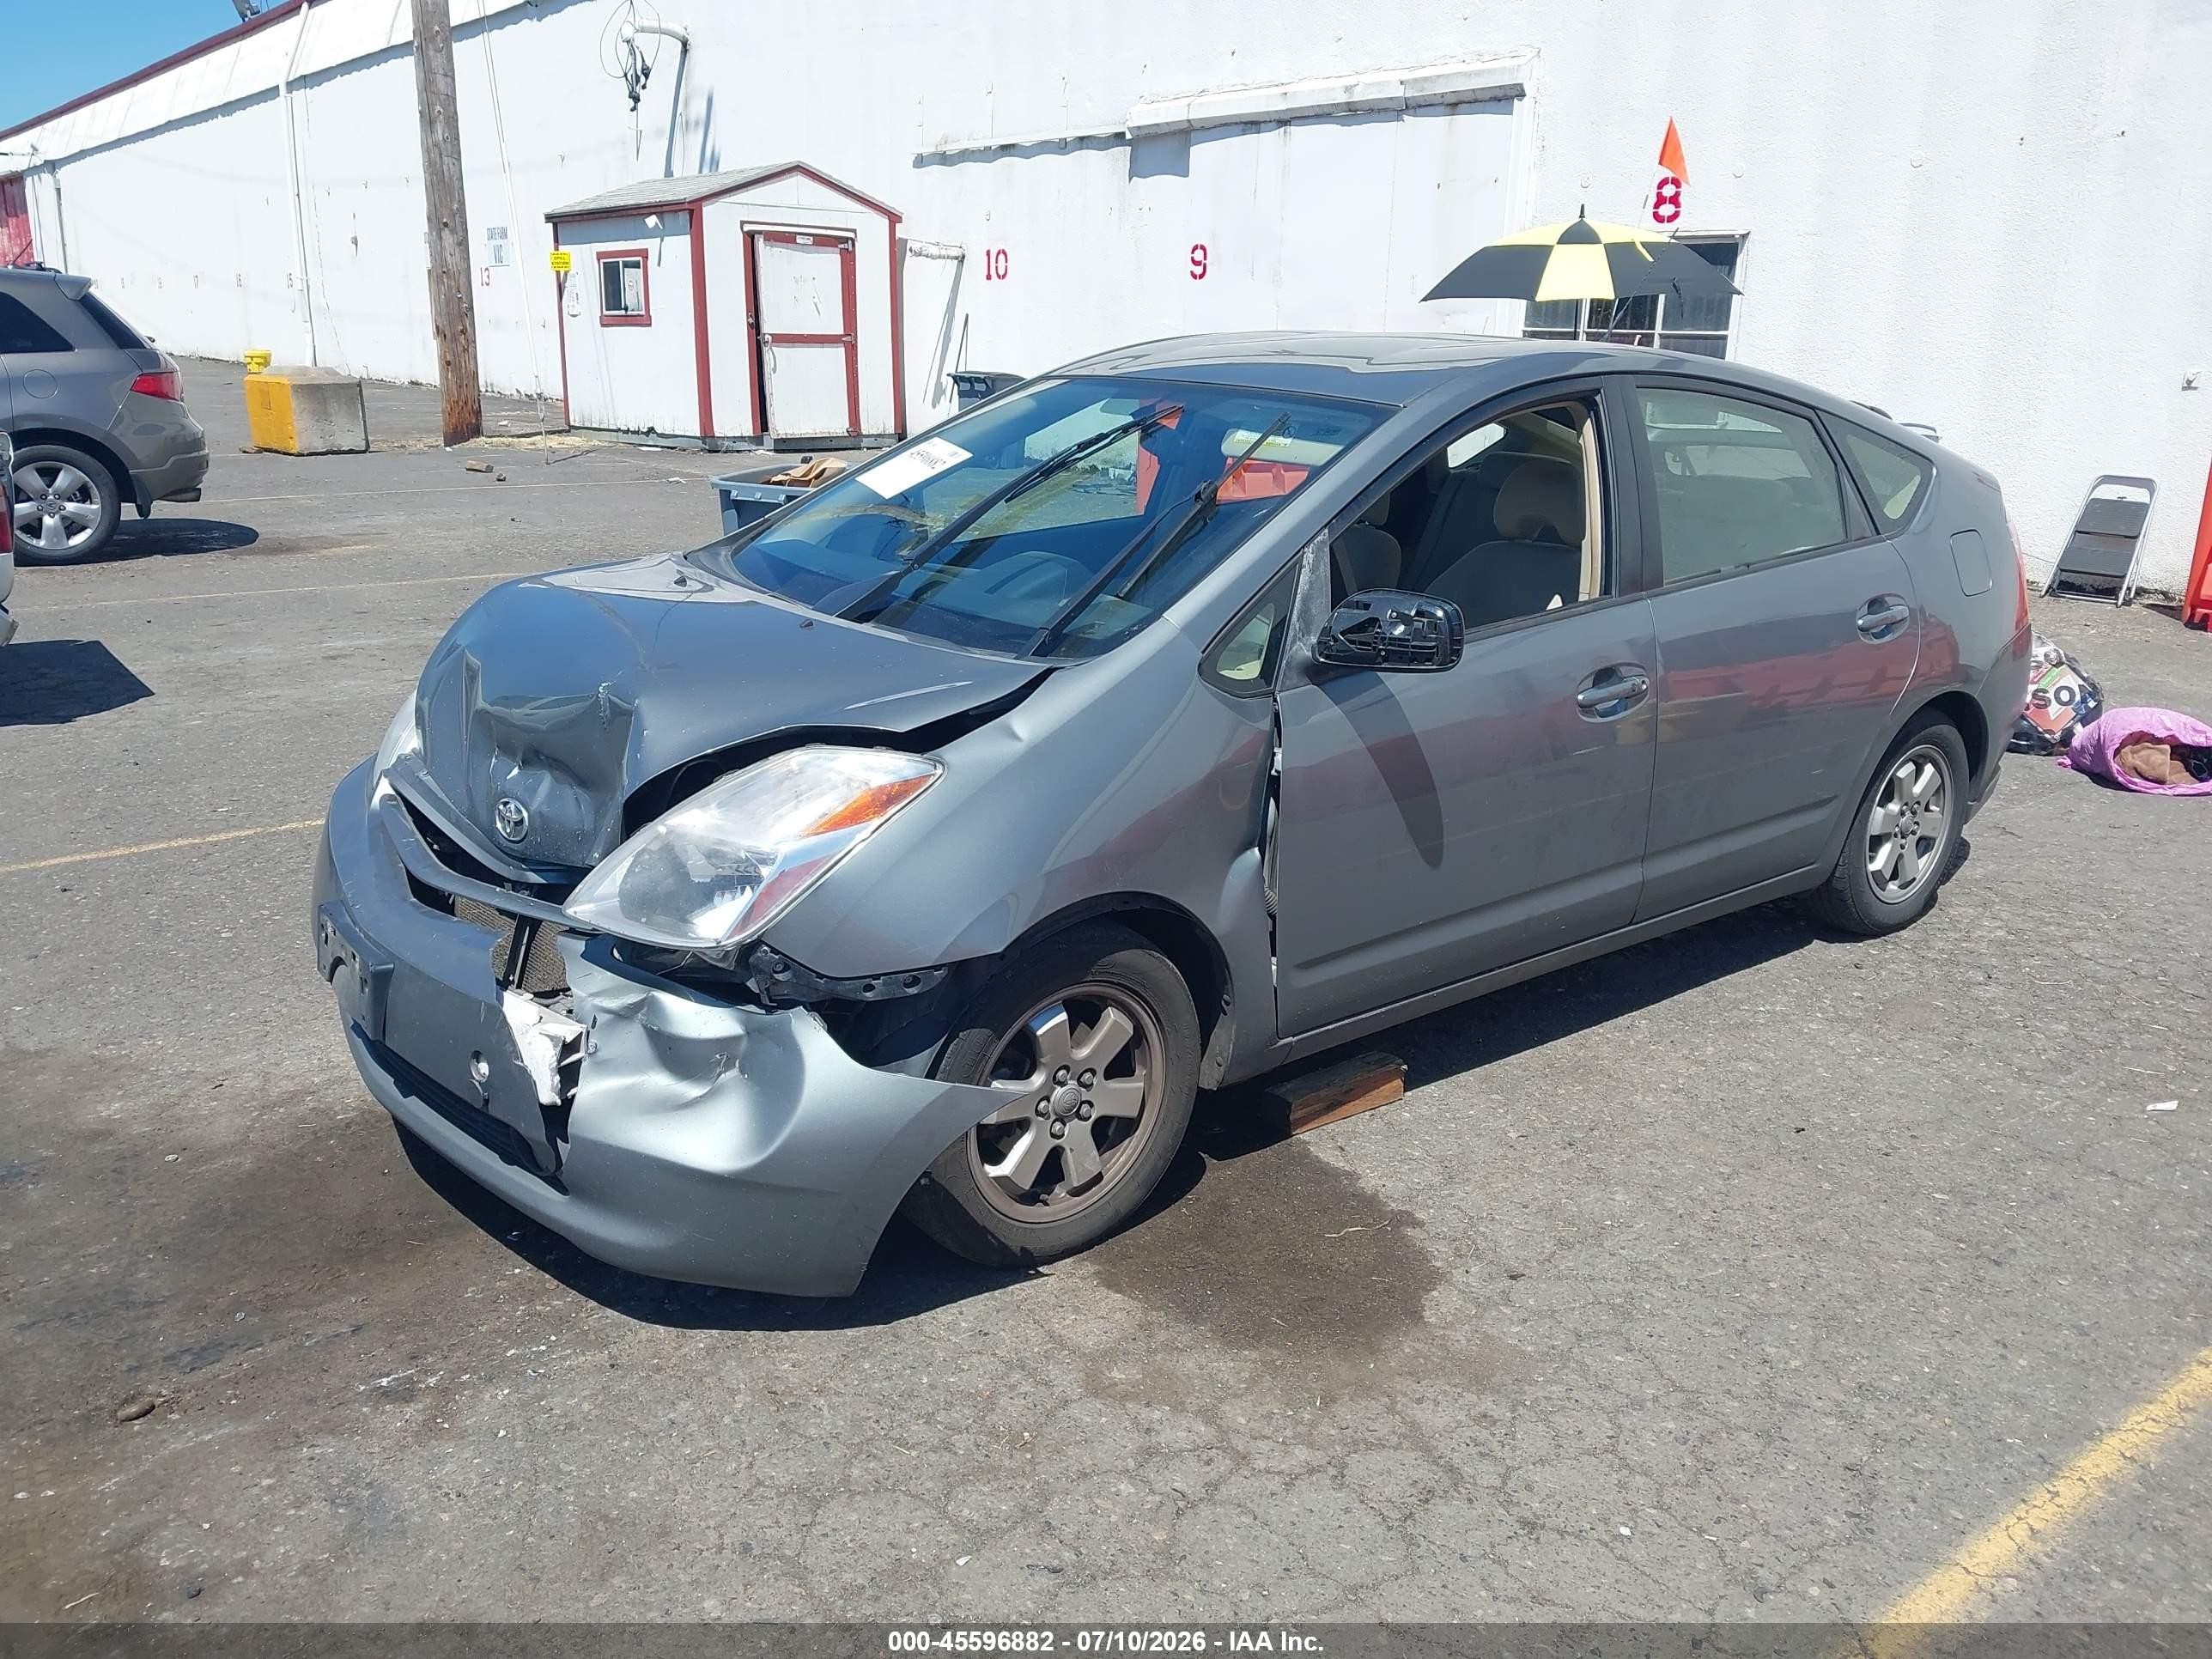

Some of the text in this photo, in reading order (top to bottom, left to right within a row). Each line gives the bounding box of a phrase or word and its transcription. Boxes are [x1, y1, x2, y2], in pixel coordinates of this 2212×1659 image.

[1652, 176, 1682, 223] 8
[486, 226, 508, 240] STATE FARM
[493, 244, 503, 264] VIC
[985, 248, 1008, 280] 10
[1190, 243, 1207, 280] 9
[286, 272, 294, 289] 15
[480, 267, 490, 286] 13
